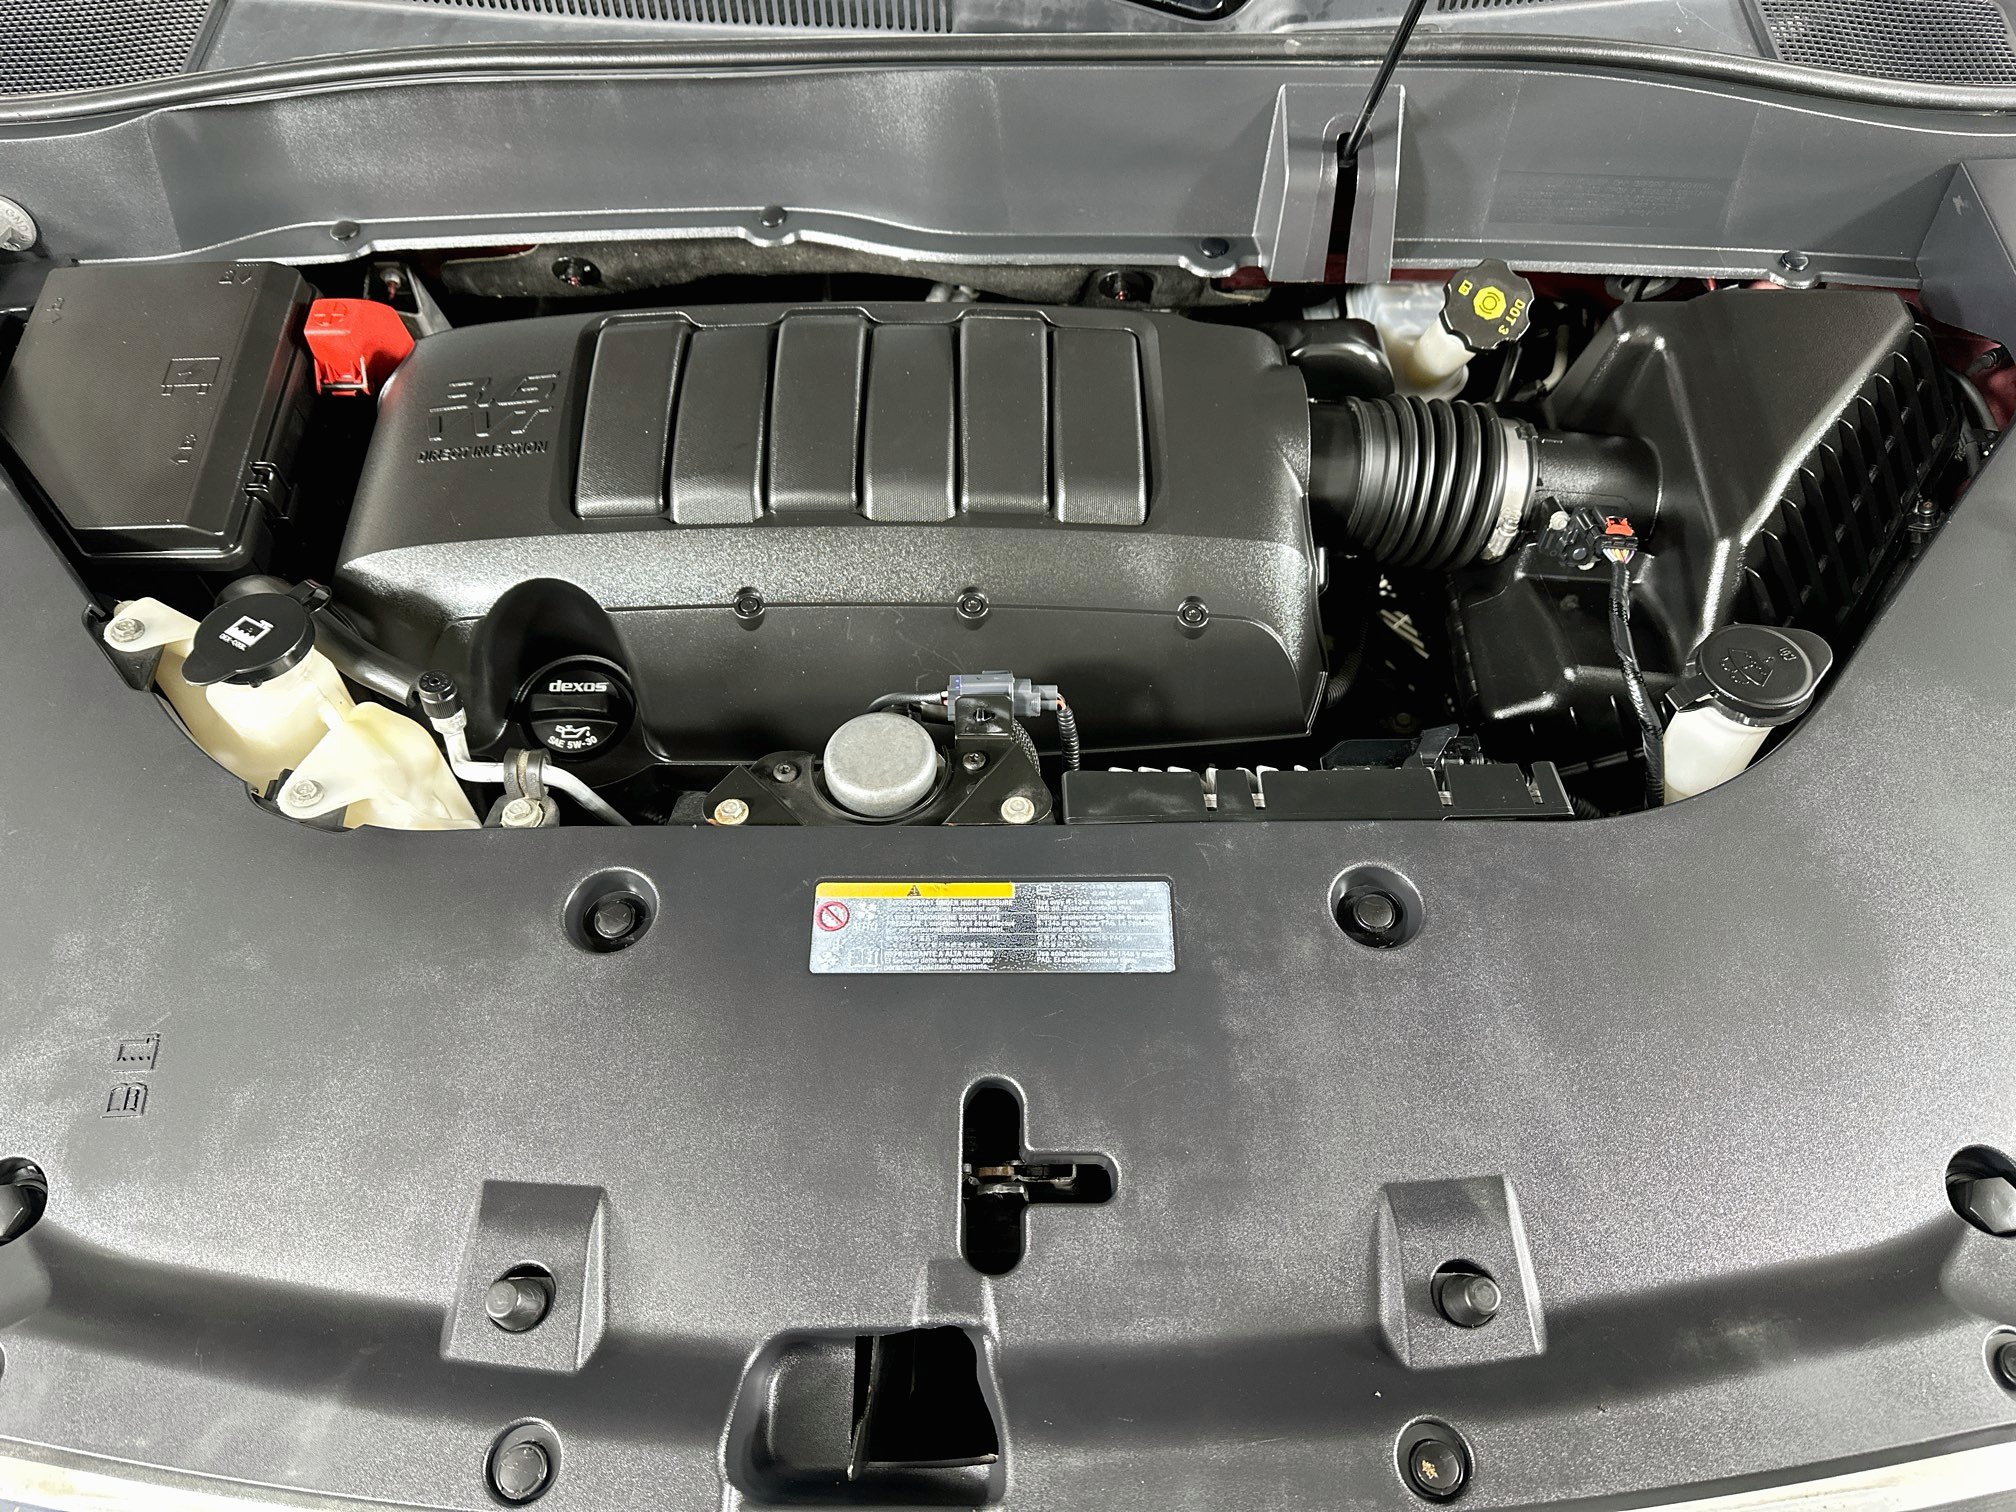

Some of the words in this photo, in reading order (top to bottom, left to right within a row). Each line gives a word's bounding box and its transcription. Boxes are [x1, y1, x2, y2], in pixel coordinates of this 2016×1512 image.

[1506, 299, 1526, 326] DOT
[1498, 325, 1509, 335] 3
[417, 446, 470, 463] DIRECT
[472, 440, 549, 459] INJECTION
[548, 679, 609, 692] dexos
[547, 735, 565, 748] SAE
[567, 735, 598, 749] 5W-30
